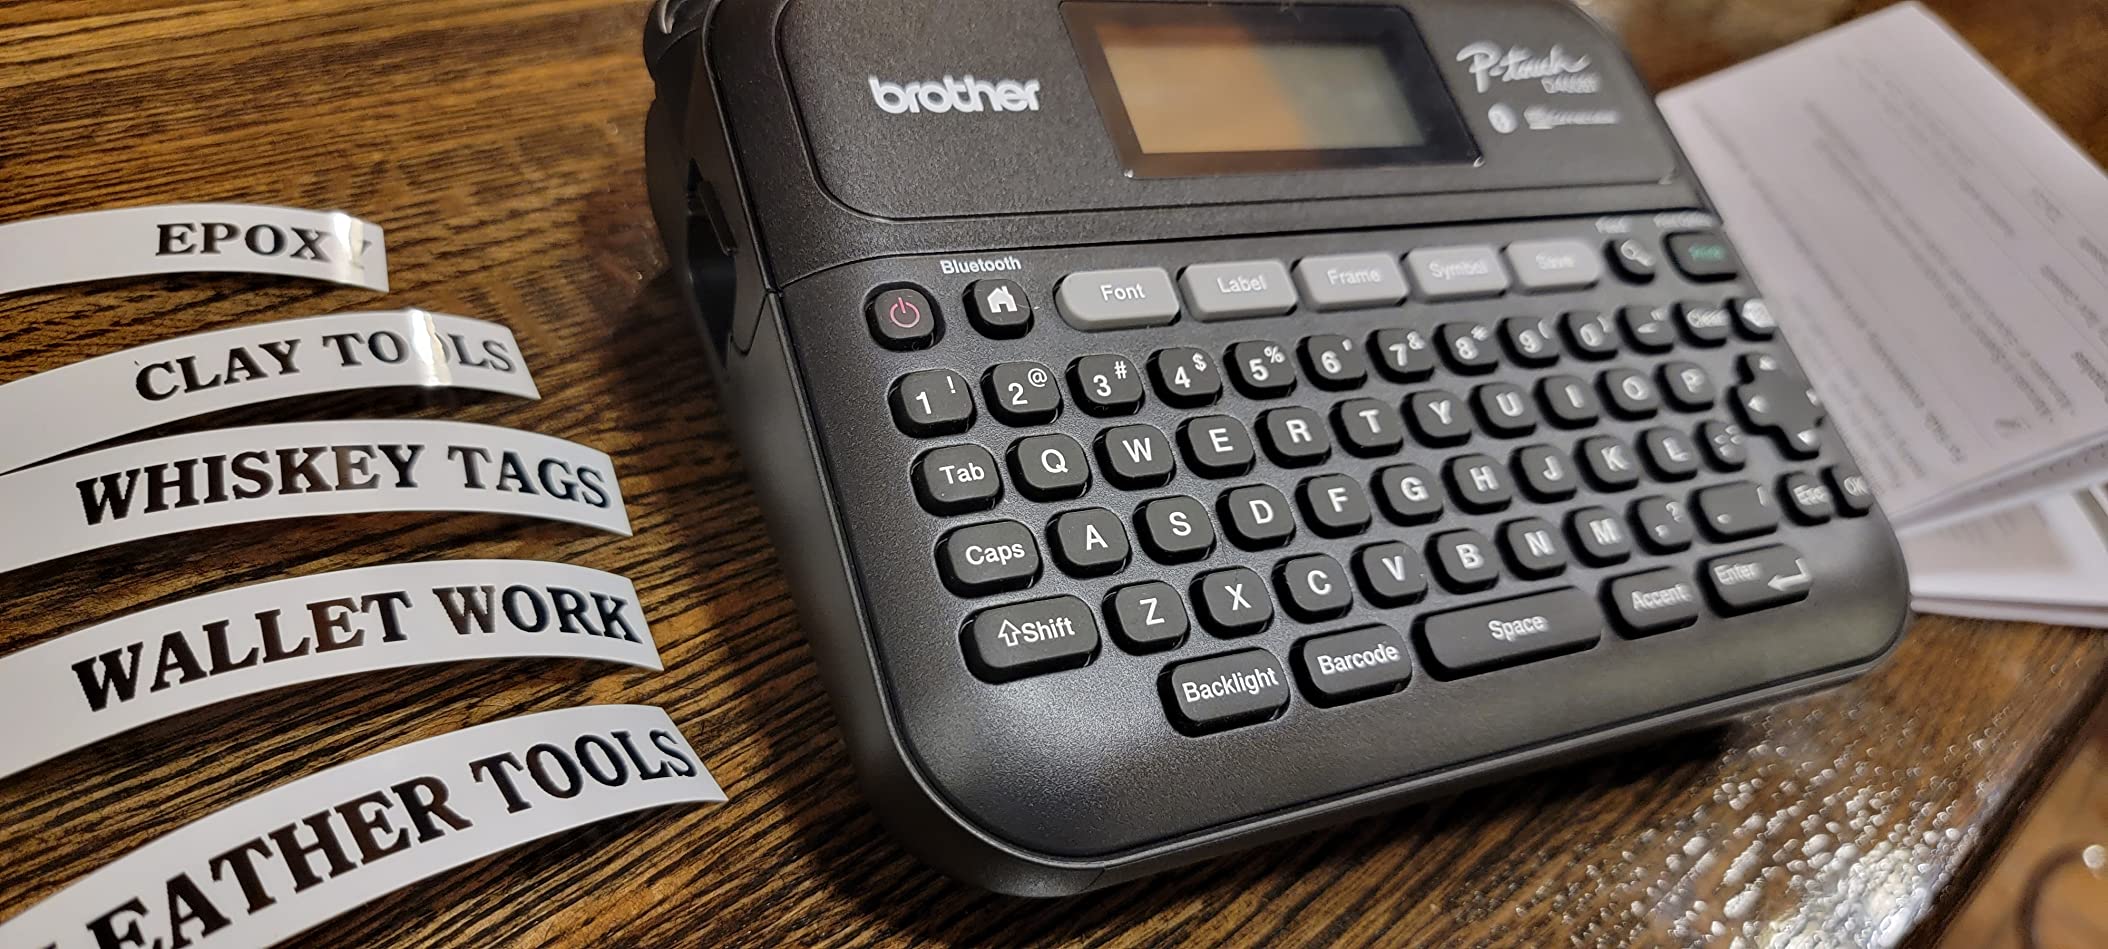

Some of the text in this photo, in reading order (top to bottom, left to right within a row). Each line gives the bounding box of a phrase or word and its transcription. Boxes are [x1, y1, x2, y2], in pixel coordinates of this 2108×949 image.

[868, 75, 1040, 114] brother
[939, 255, 1022, 275] Bluetooth
[1327, 267, 1382, 286] Frame
[1100, 283, 1146, 301] Font
[1217, 274, 1267, 293] Label
[1455, 336, 1478, 360] 8
[1519, 330, 1541, 353] 9
[1321, 351, 1342, 374] 6
[1389, 343, 1407, 366] 7
[135, 340, 301, 401] CLAY
[1174, 367, 1191, 389] 4
[1249, 358, 1269, 381] 5
[1681, 369, 1702, 393] P
[1008, 382, 1028, 405] 2
[1093, 374, 1112, 397] 3
[1623, 376, 1650, 400] O
[916, 391, 932, 415] 1
[1428, 400, 1452, 424] Y
[1496, 392, 1524, 417] U
[1286, 419, 1312, 443] R
[1359, 409, 1380, 433] T
[1122, 438, 1153, 463] W
[1208, 428, 1233, 452] E
[1663, 437, 1688, 462] L
[1041, 449, 1068, 474] Q
[1543, 456, 1563, 481] J
[1601, 445, 1630, 471] K
[76, 444, 611, 526] WHISKEY TAGS
[938, 463, 985, 485] Tab
[1469, 466, 1499, 492] H
[1328, 487, 1348, 512] F
[1401, 477, 1429, 501] G
[1169, 512, 1192, 536] S
[1248, 500, 1273, 525] D
[1086, 525, 1108, 550] A
[1524, 530, 1555, 556] N
[1590, 518, 1622, 545] M
[965, 542, 1025, 566] Caps
[1456, 543, 1484, 569] B
[1382, 556, 1405, 581] V
[1714, 562, 1760, 585] Enter
[1307, 570, 1332, 595] C
[1225, 584, 1251, 611] X
[1631, 583, 1692, 611] Accent
[1140, 598, 1164, 625] Z
[1021, 618, 1075, 643] Shift
[1488, 616, 1549, 642] Space
[71, 584, 643, 713] WALLET WORK
[1317, 643, 1400, 677] Barcode
[1182, 667, 1279, 703] Backlight
[40, 728, 699, 949] EATHER TOOLS
